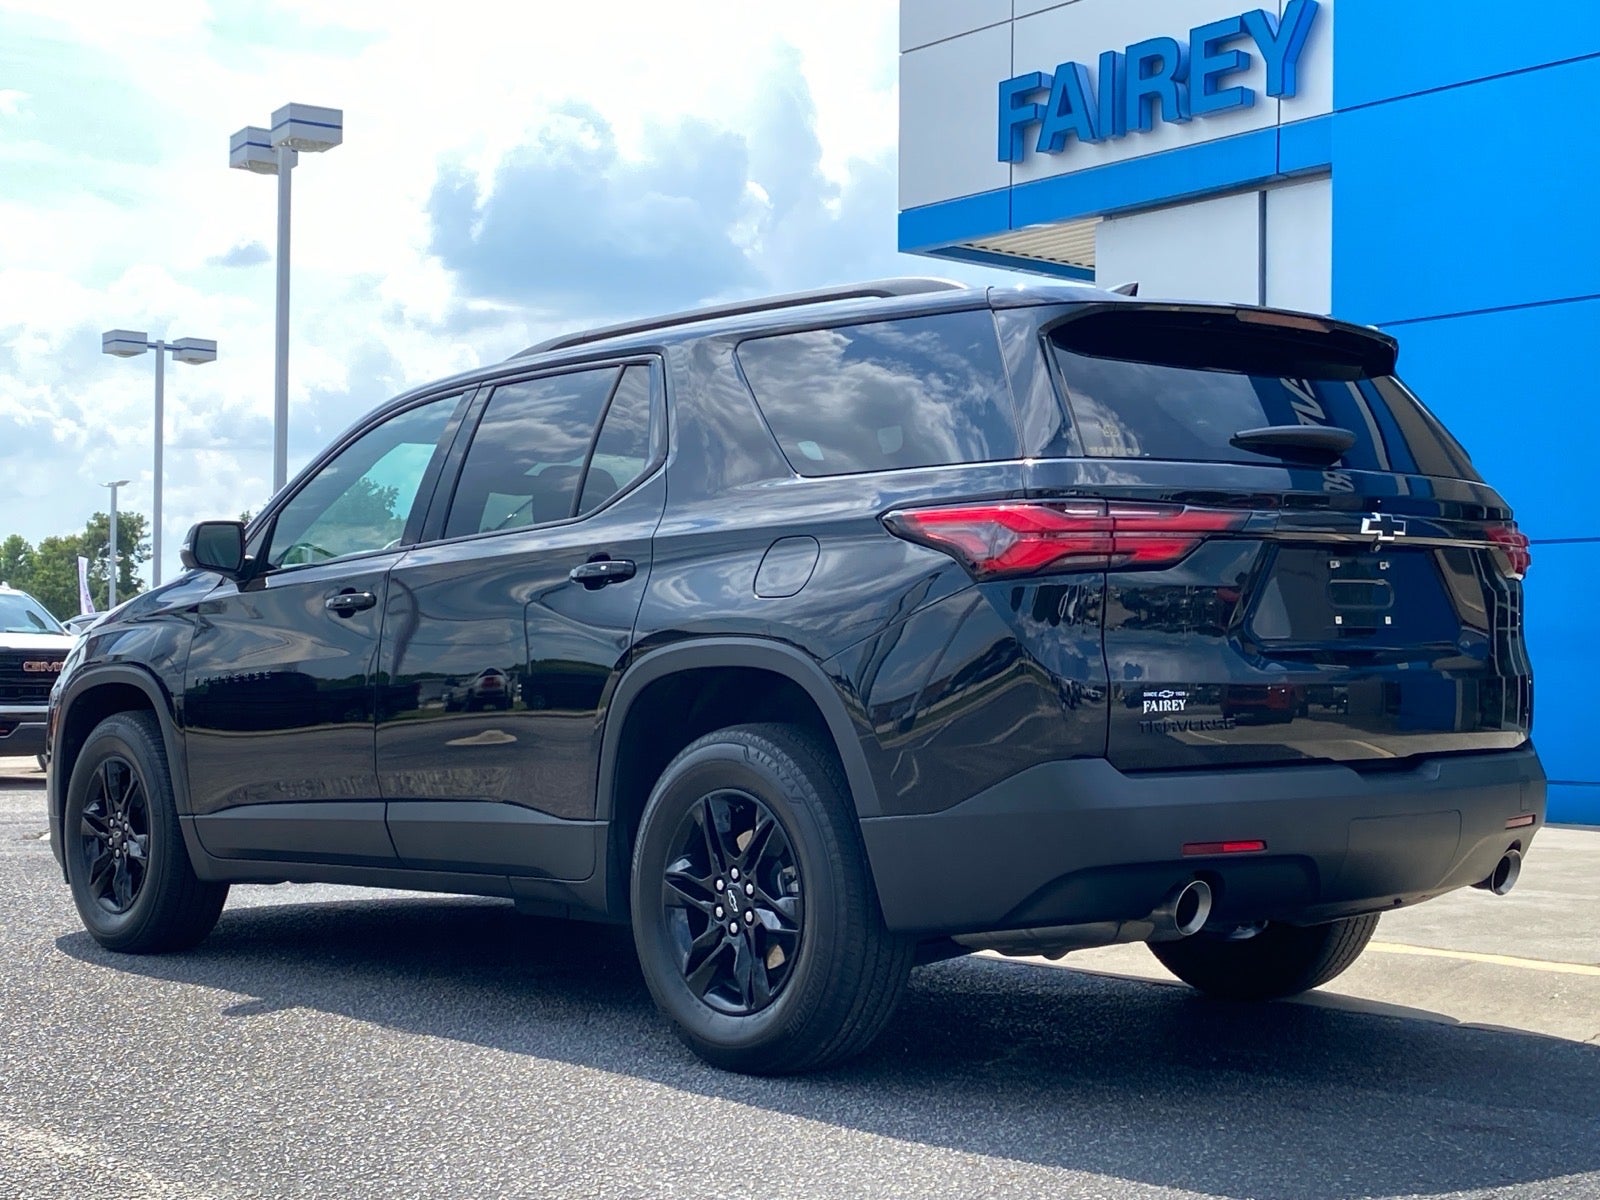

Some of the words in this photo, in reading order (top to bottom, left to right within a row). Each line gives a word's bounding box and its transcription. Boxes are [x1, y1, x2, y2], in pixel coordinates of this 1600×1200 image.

[998, 0, 1318, 163] FAIREY
[1143, 699, 1187, 714] FAIREY
[1139, 717, 1236, 734] TRAVERSE
